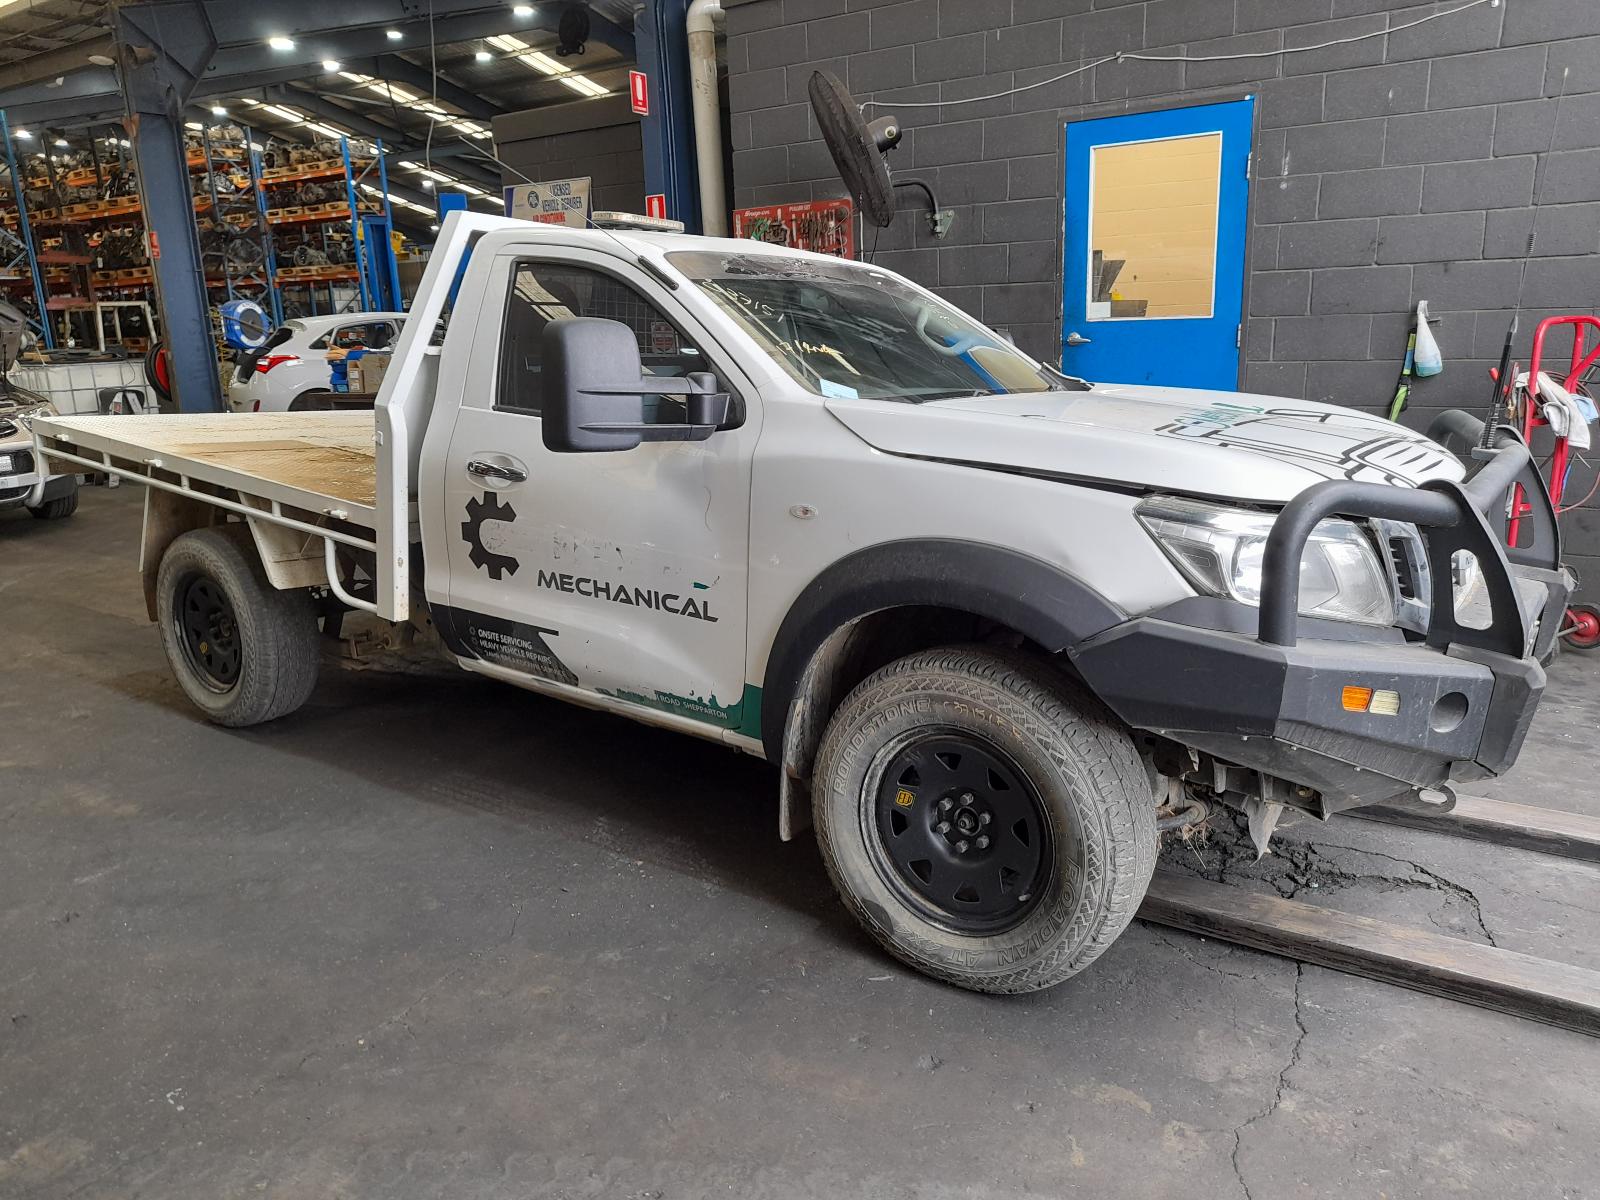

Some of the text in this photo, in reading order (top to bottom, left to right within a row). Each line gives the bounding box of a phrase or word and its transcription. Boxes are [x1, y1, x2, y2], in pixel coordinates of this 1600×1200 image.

[549, 183, 571, 197] LICENSED
[542, 199, 560, 212] VEHICLE
[537, 569, 718, 622] MECHANICAL
[478, 629, 533, 649] ONSITE SERVICING
[479, 639, 552, 664] HEAVY VEHICLE REPAIRS
[659, 694, 728, 720] ROAD SHEPPARTON
[833, 698, 932, 796] ROADSTONE
[996, 856, 1082, 967] ROADIAN
